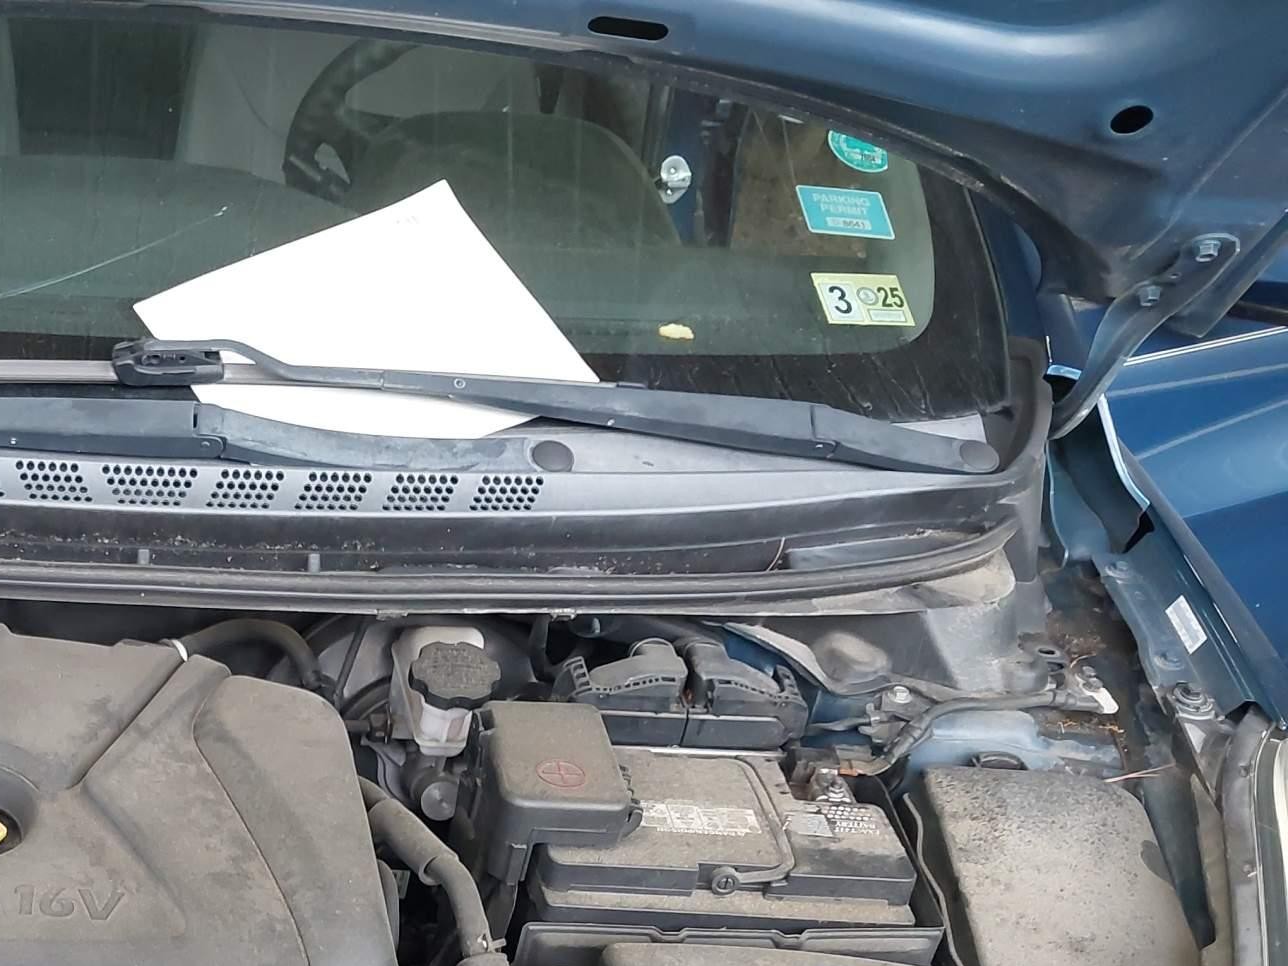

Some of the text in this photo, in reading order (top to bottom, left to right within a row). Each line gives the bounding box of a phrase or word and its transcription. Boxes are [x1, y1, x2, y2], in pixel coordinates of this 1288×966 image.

[812, 192, 871, 207] PARKING
[820, 203, 867, 216] PERMIT
[828, 286, 905, 315] 3 25
[13, 883, 126, 921] 16V
